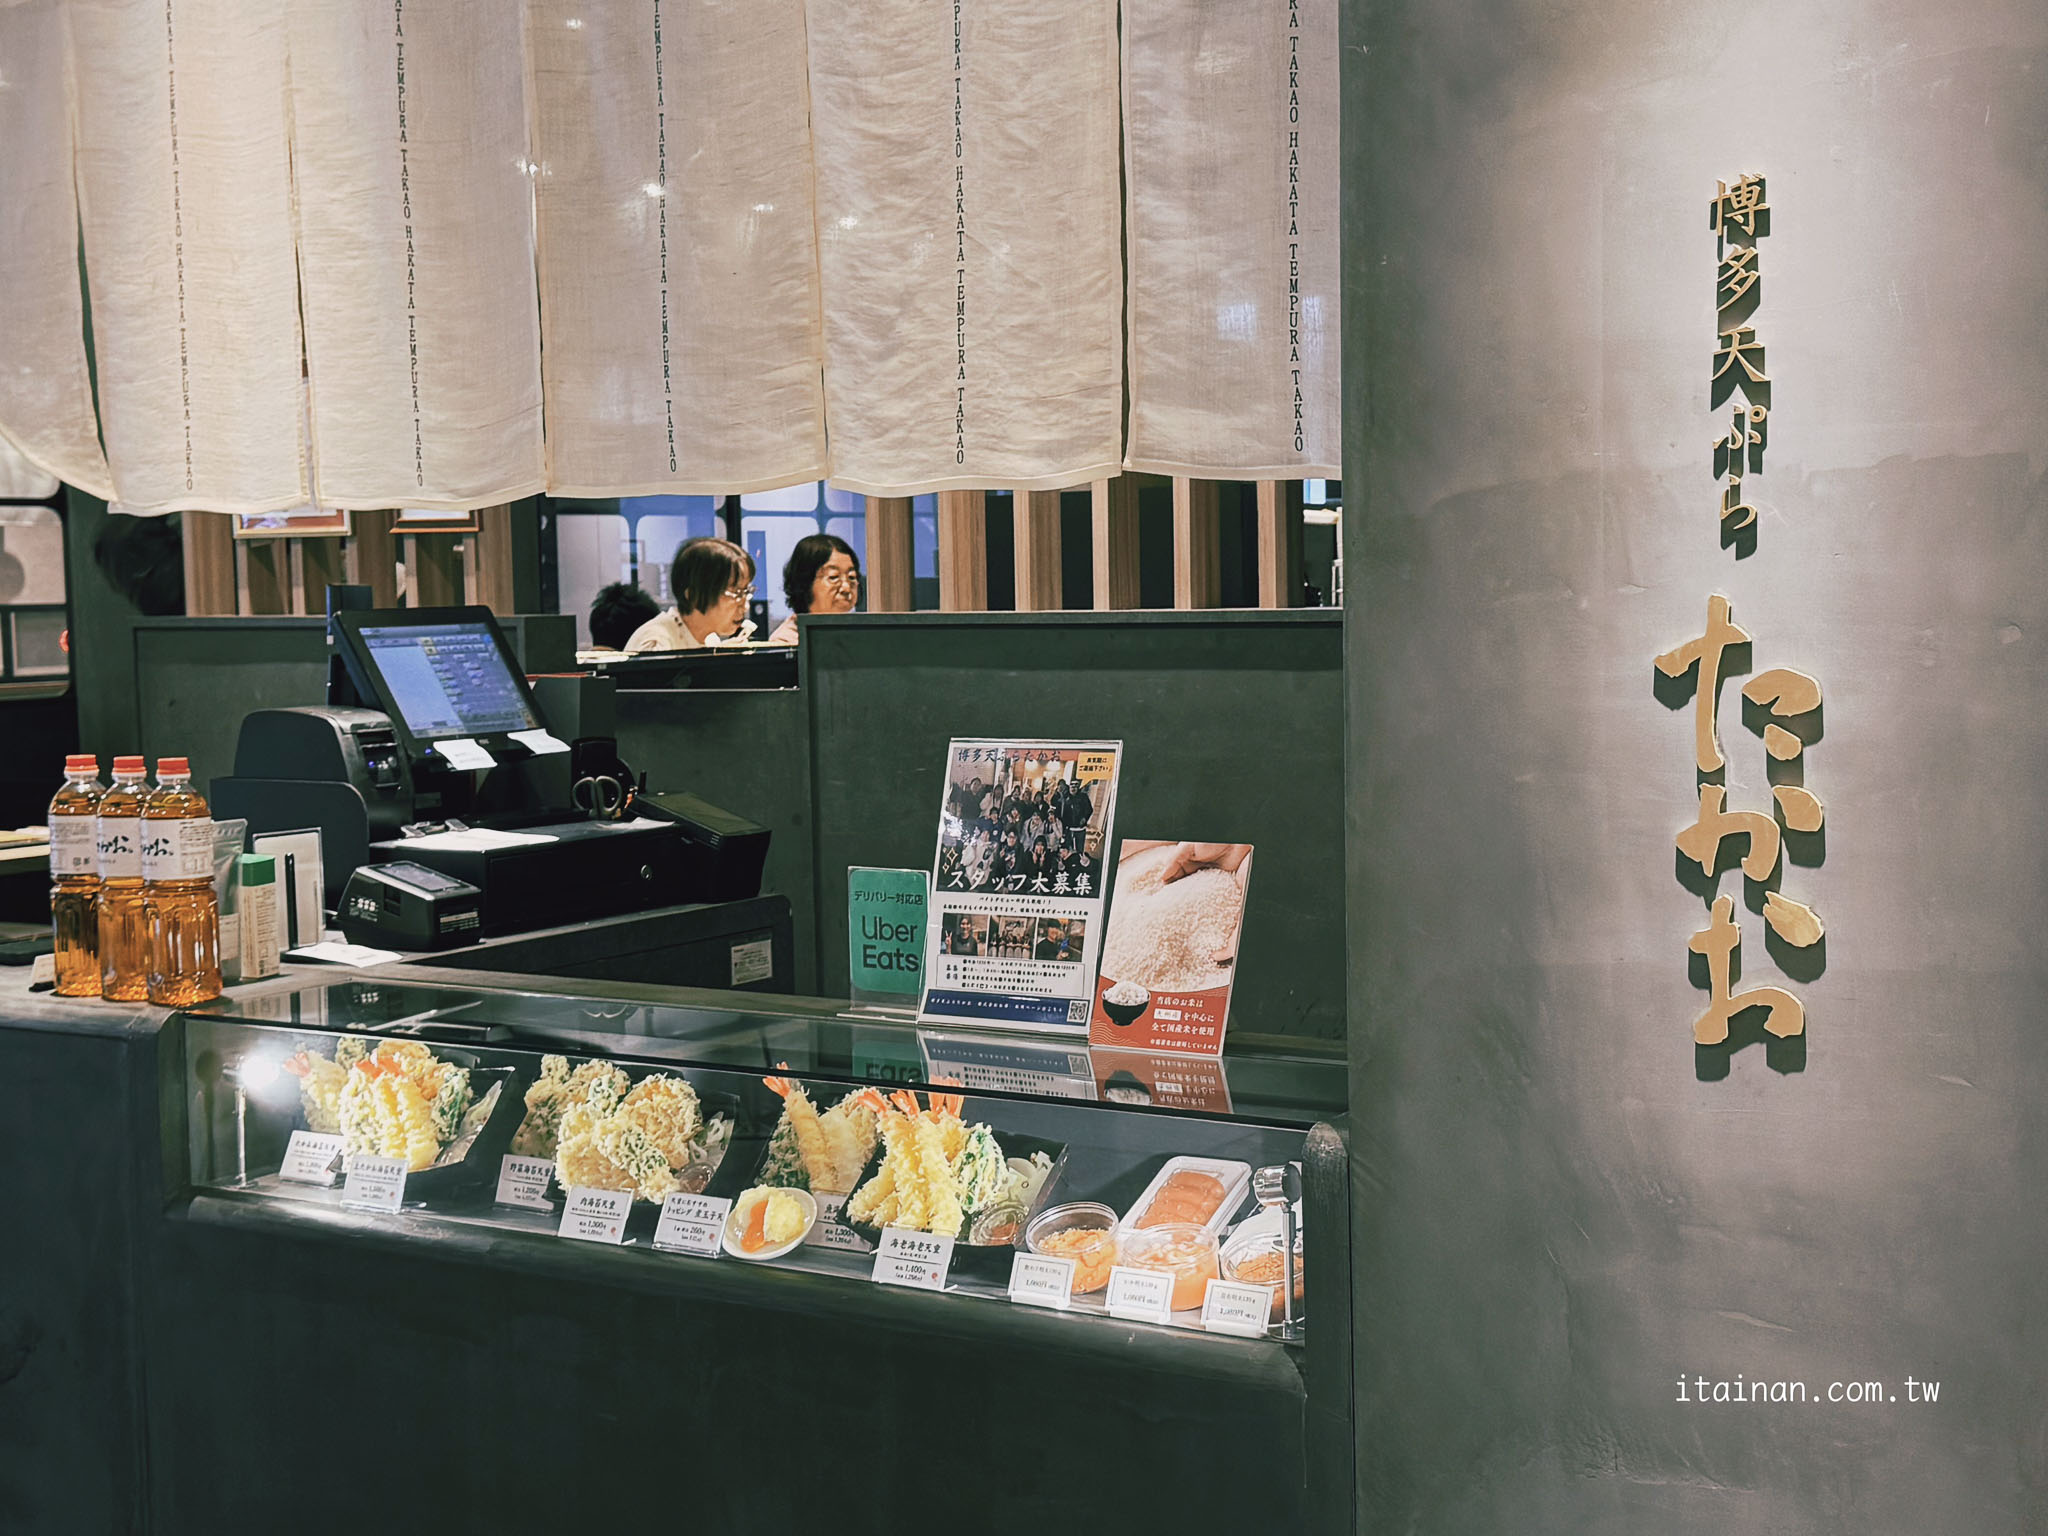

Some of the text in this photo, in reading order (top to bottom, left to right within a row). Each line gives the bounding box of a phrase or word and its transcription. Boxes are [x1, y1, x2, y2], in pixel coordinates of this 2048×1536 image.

[168, 71, 179, 165] TEMPURA
[396, 43, 408, 143] TEMPURA
[954, 78, 963, 159] TAKAO
[1288, 36, 1299, 124] TAKAO
[173, 171, 182, 238] TAKAO
[400, 149, 412, 219] TAKAO
[955, 165, 965, 263] HAKATA
[1288, 131, 1299, 236] HAKATA
[405, 225, 416, 310] HAKATA
[653, 0, 677, 473] TEMPURA TAKAO HAKATA TEMPURA TAKAO
[175, 243, 186, 323] HAKATA
[1288, 243, 1300, 362] TEMPURA
[408, 315, 420, 413] TEMPURA
[956, 269, 967, 380] TEMPURA
[1709, 172, 1772, 532] 博多天ぷら
[180, 328, 191, 421] TEMPURA
[1290, 369, 1304, 453] TAKAO
[185, 426, 194, 491] TAKAO
[414, 419, 424, 487] TAKAO
[955, 387, 966, 465] TAKAO
[1653, 592, 1825, 1045] たかお
[854, 890, 924, 906] デリバリー対応店
[947, 870, 1093, 895] スタッフ大募集
[861, 915, 919, 943] Uber
[862, 944, 920, 972] Eats
[1151, 1022, 1215, 1036] 全て国産米を使用
[1156, 996, 1204, 1008] 当店のお米は
[1183, 1012, 1215, 1022] を中心に
